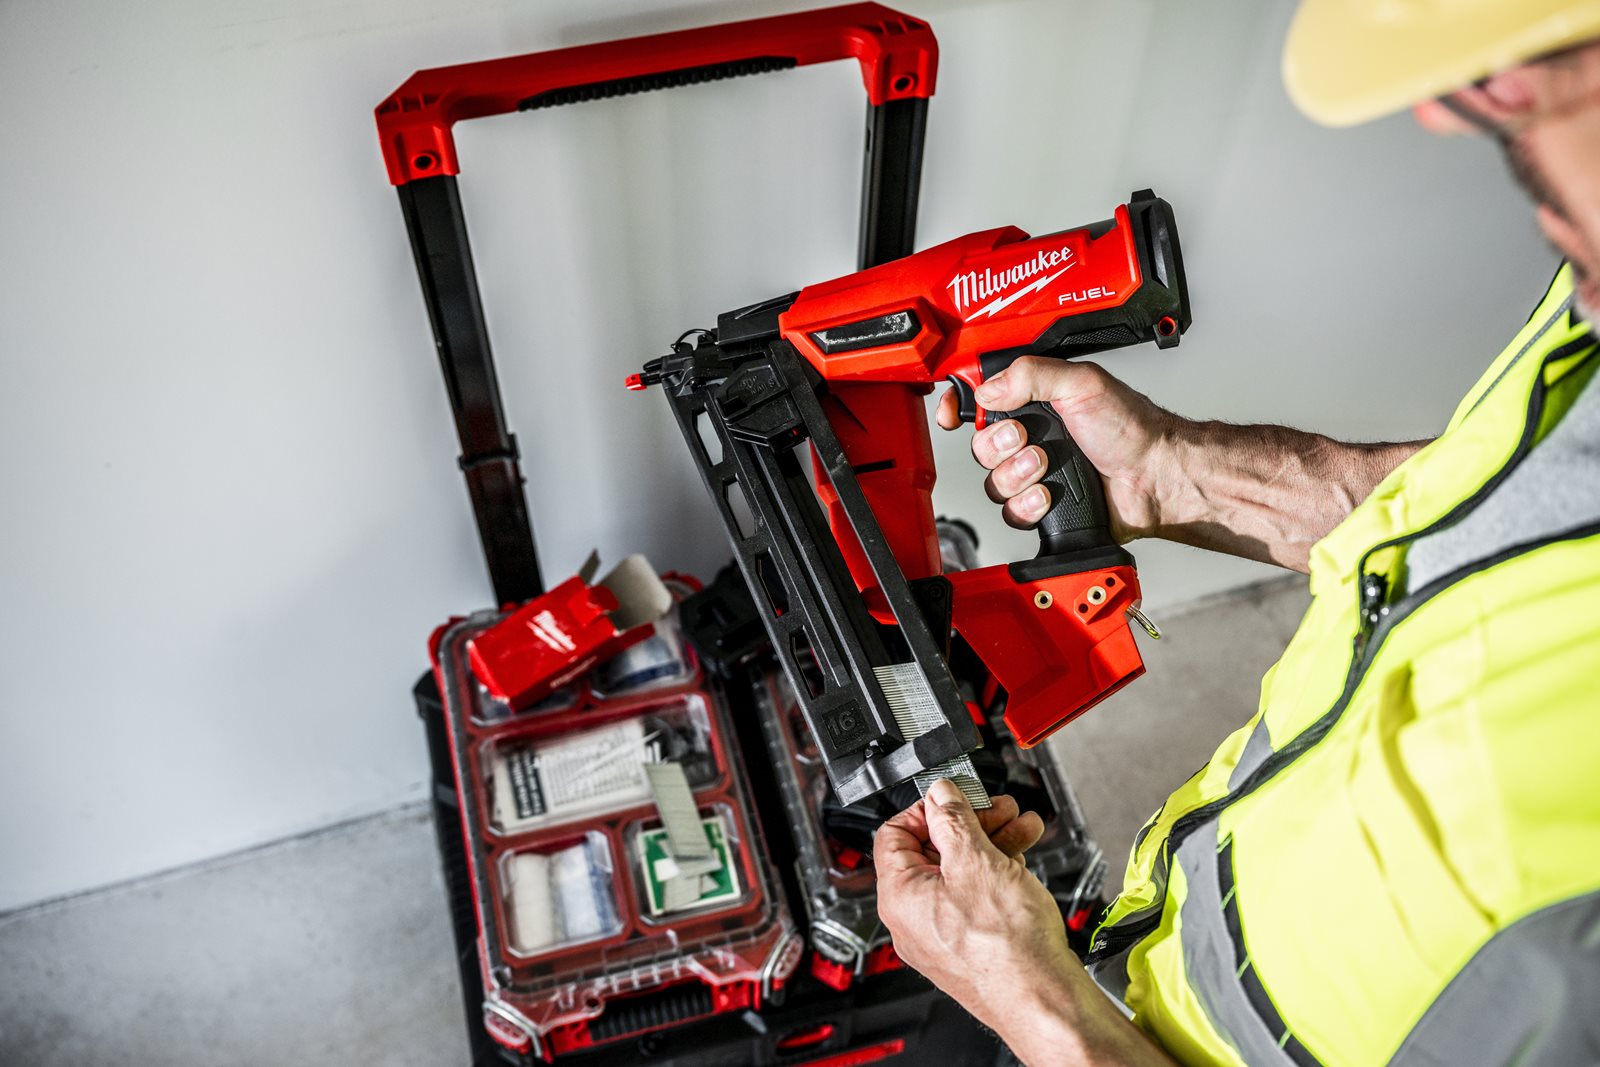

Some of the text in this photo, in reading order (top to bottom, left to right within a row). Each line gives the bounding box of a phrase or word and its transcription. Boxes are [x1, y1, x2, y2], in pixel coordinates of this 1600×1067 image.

[946, 246, 1074, 313] Milwaukee
[1058, 285, 1116, 305] FUEL
[827, 711, 857, 736] 16
